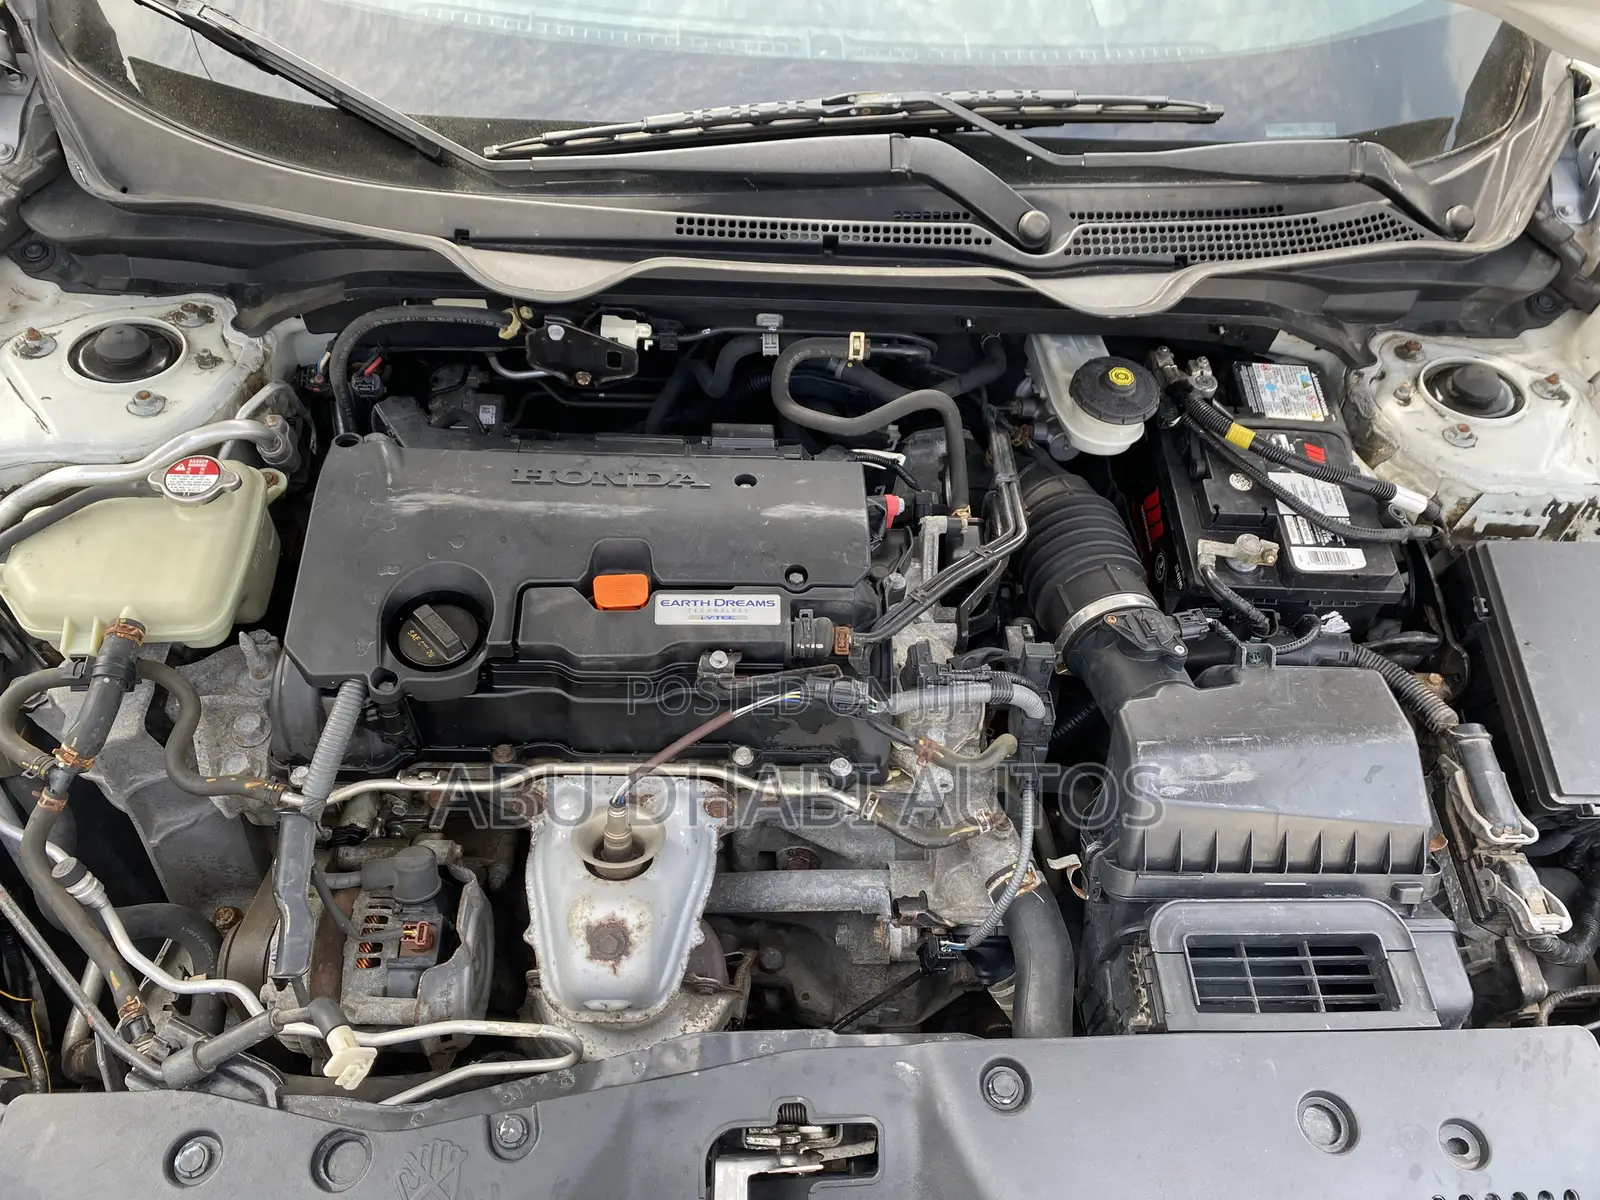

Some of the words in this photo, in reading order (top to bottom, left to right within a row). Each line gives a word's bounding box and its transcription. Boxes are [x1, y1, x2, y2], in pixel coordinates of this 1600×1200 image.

[510, 467, 711, 489] HONDA
[660, 599, 711, 607] EARTH
[714, 598, 776, 607] DREAMS
